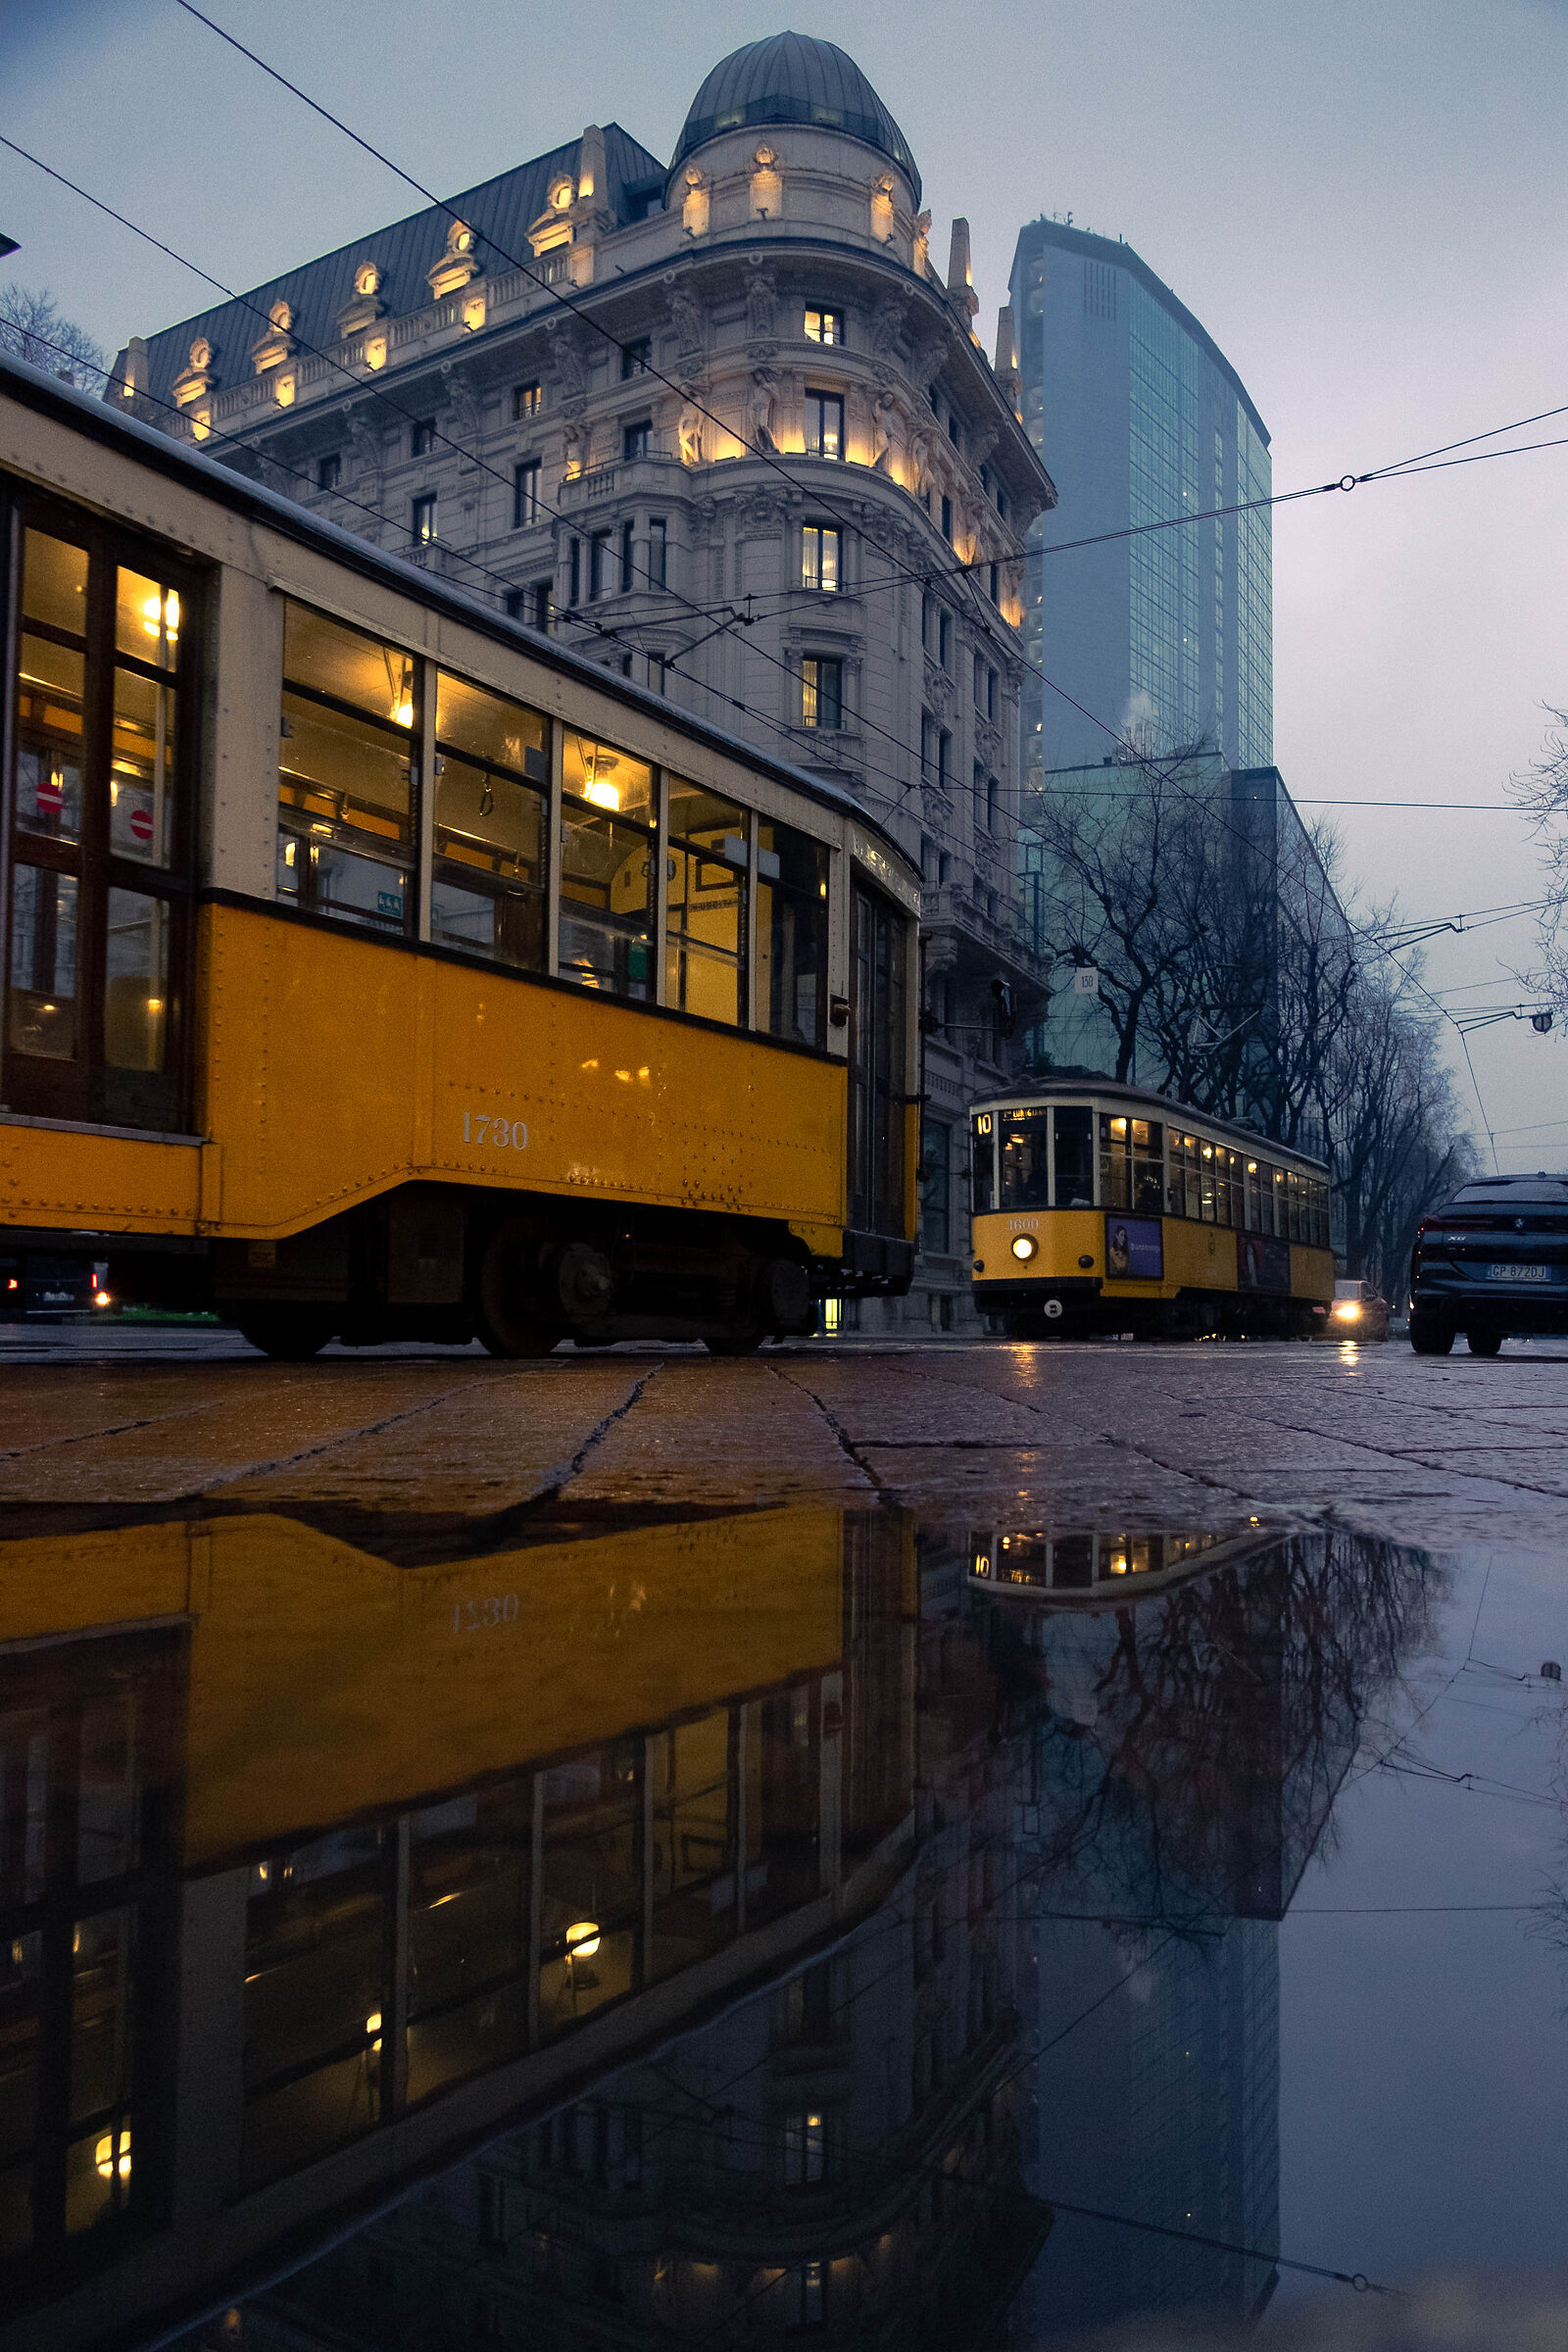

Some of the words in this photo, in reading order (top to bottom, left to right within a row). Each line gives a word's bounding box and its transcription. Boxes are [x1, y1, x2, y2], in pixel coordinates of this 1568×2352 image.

[463, 1111, 528, 1151] 1730
[977, 1113, 992, 1135] 10
[1008, 1217, 1039, 1231] 1600
